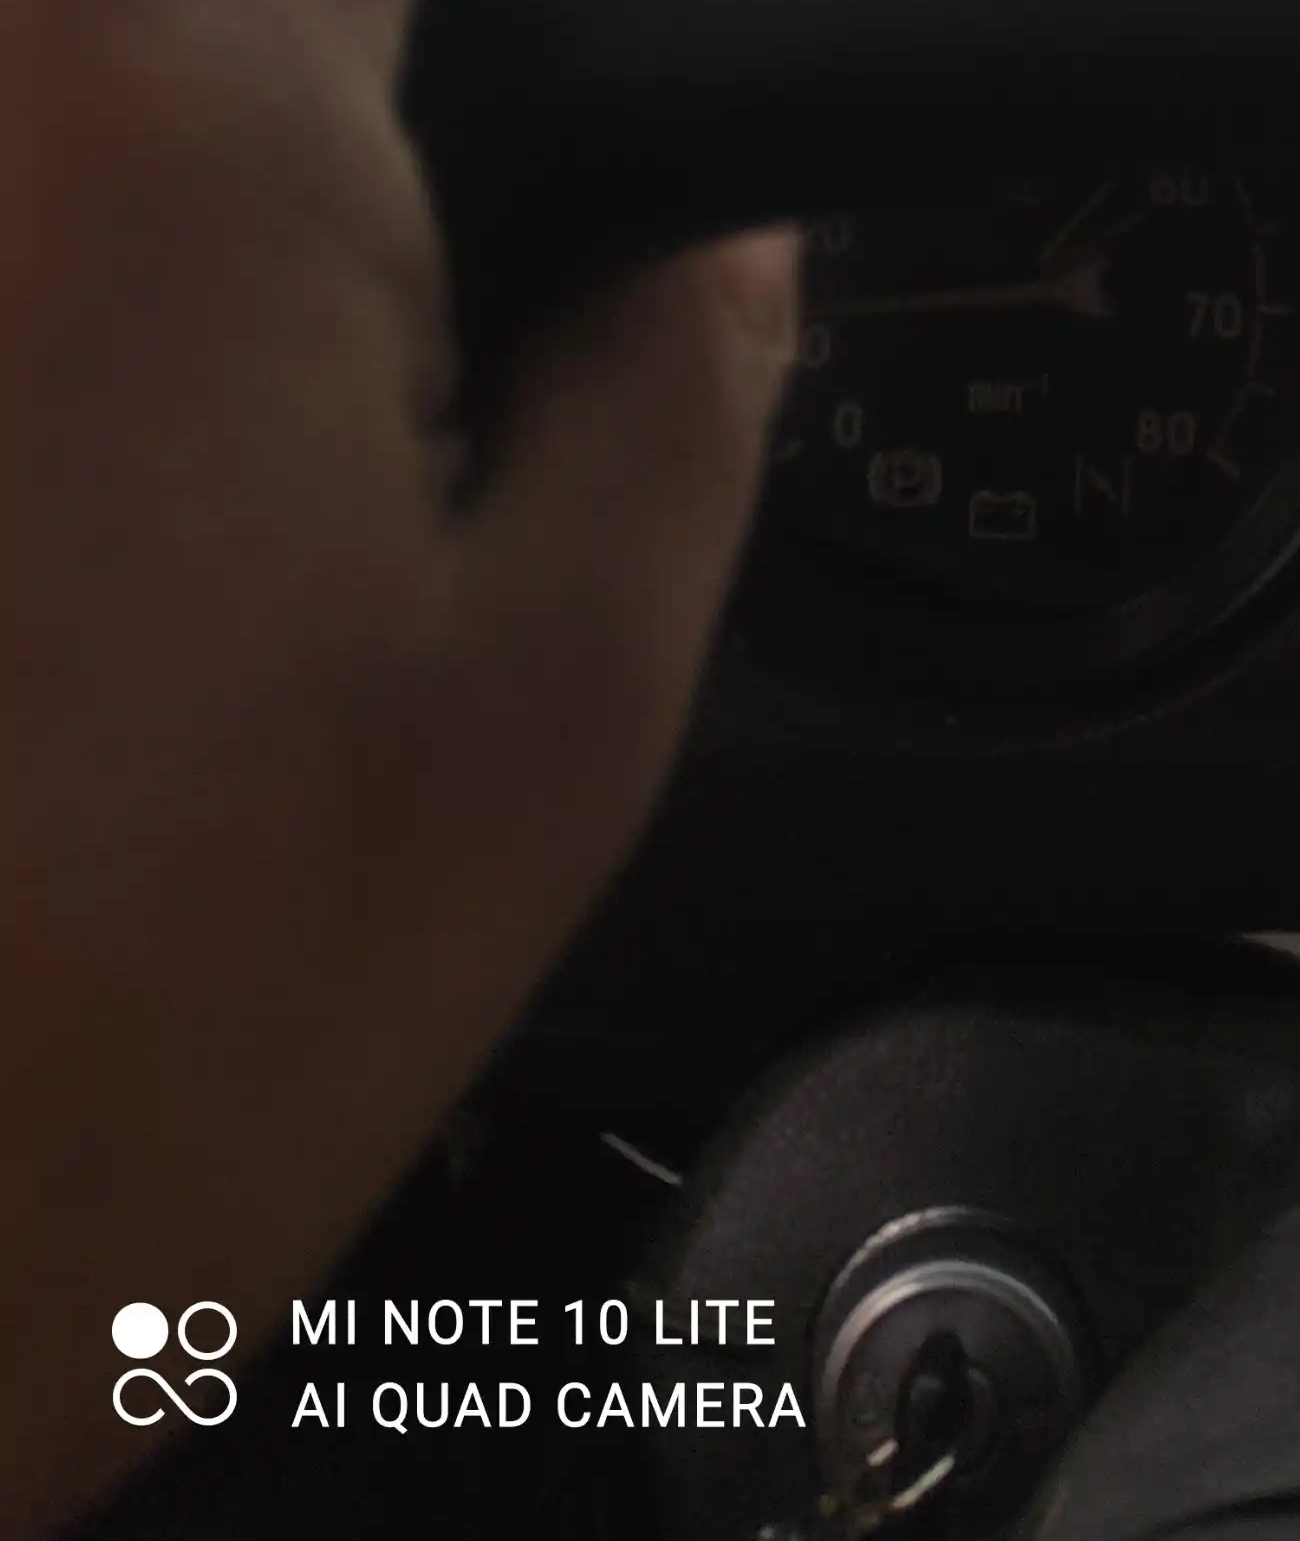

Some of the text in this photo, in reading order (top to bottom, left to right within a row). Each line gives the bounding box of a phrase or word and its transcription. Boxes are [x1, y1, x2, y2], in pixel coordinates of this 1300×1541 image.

[1187, 289, 1243, 341] 70
[833, 399, 864, 449] 0
[1135, 408, 1199, 457] 80
